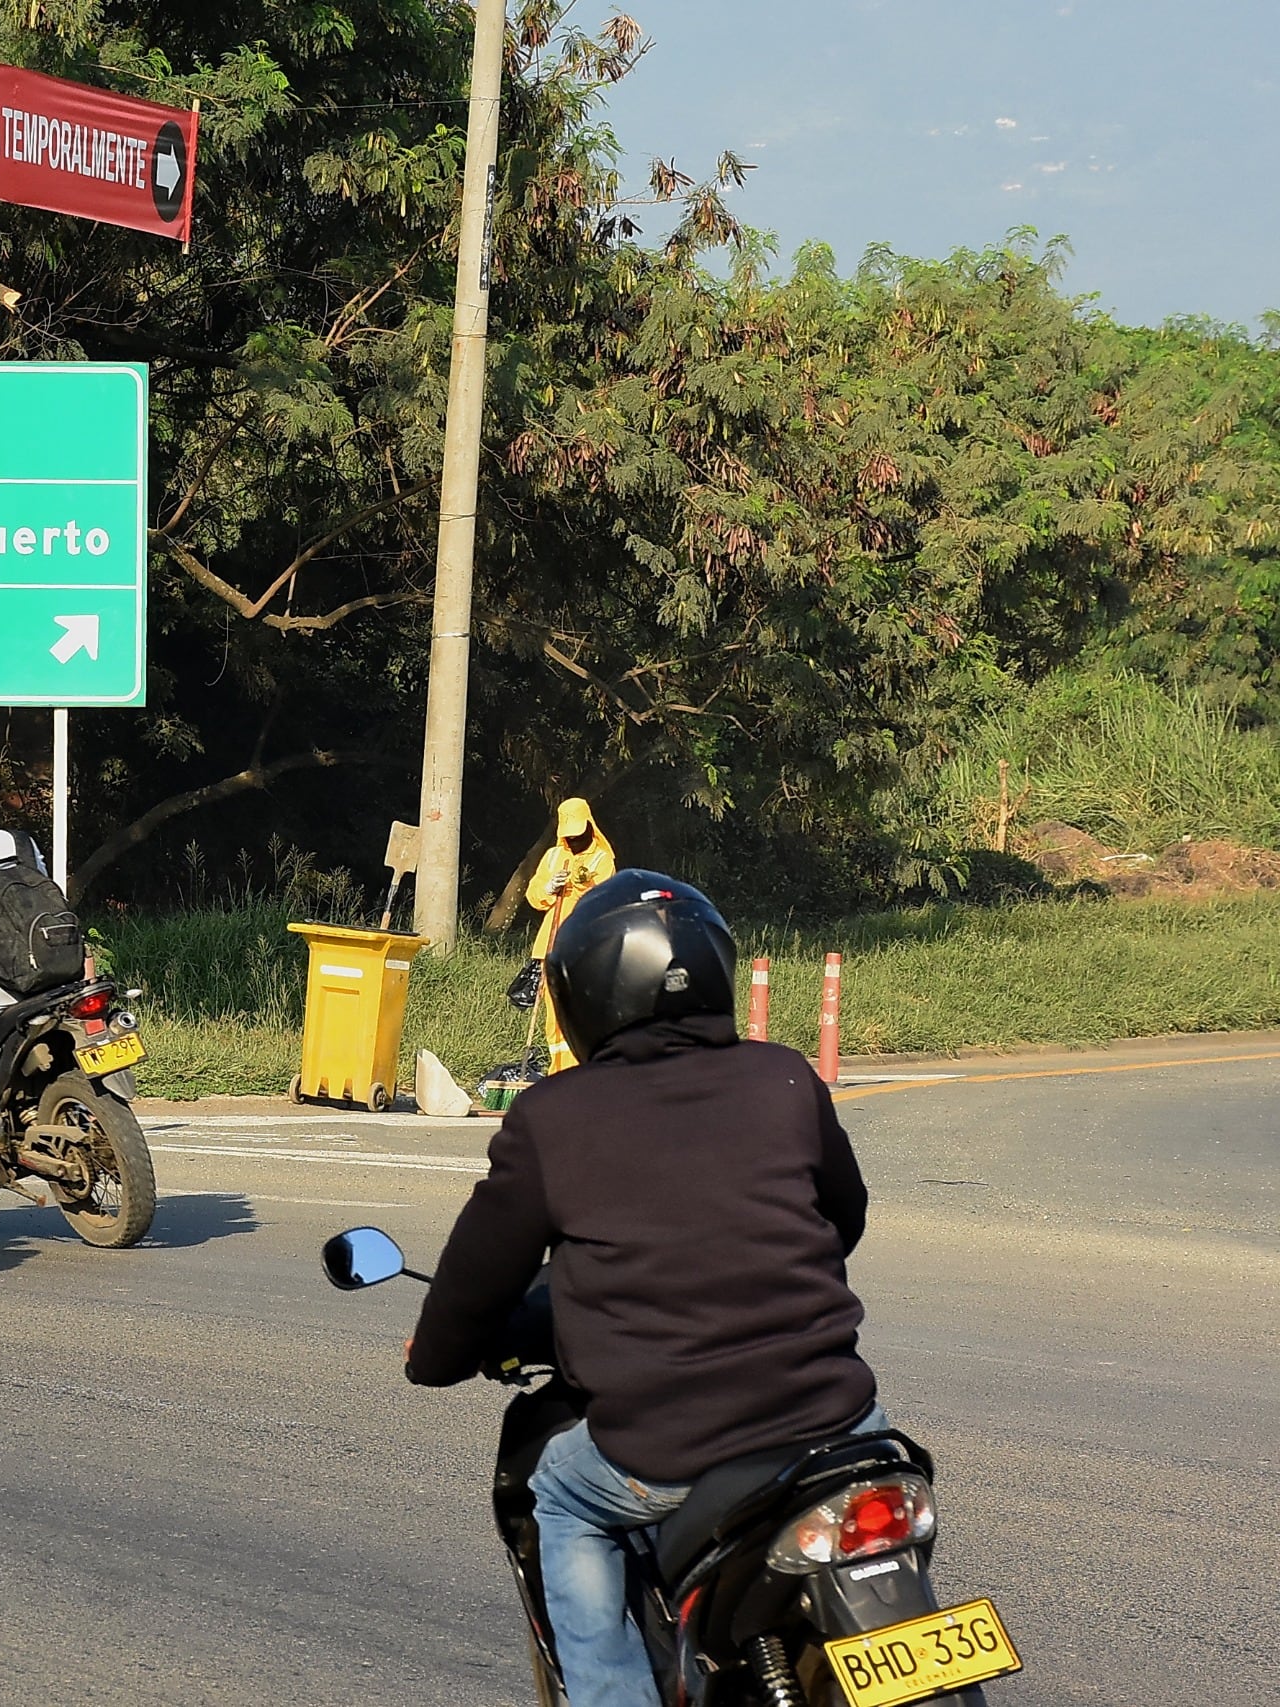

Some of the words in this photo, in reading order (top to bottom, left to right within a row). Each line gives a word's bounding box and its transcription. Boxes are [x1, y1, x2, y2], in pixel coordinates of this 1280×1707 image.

[1, 107, 148, 190] TEMPORALMENTE
[111, 1037, 136, 1058] 29F
[842, 1640, 918, 1691] BHD
[921, 1617, 999, 1666] 33G
